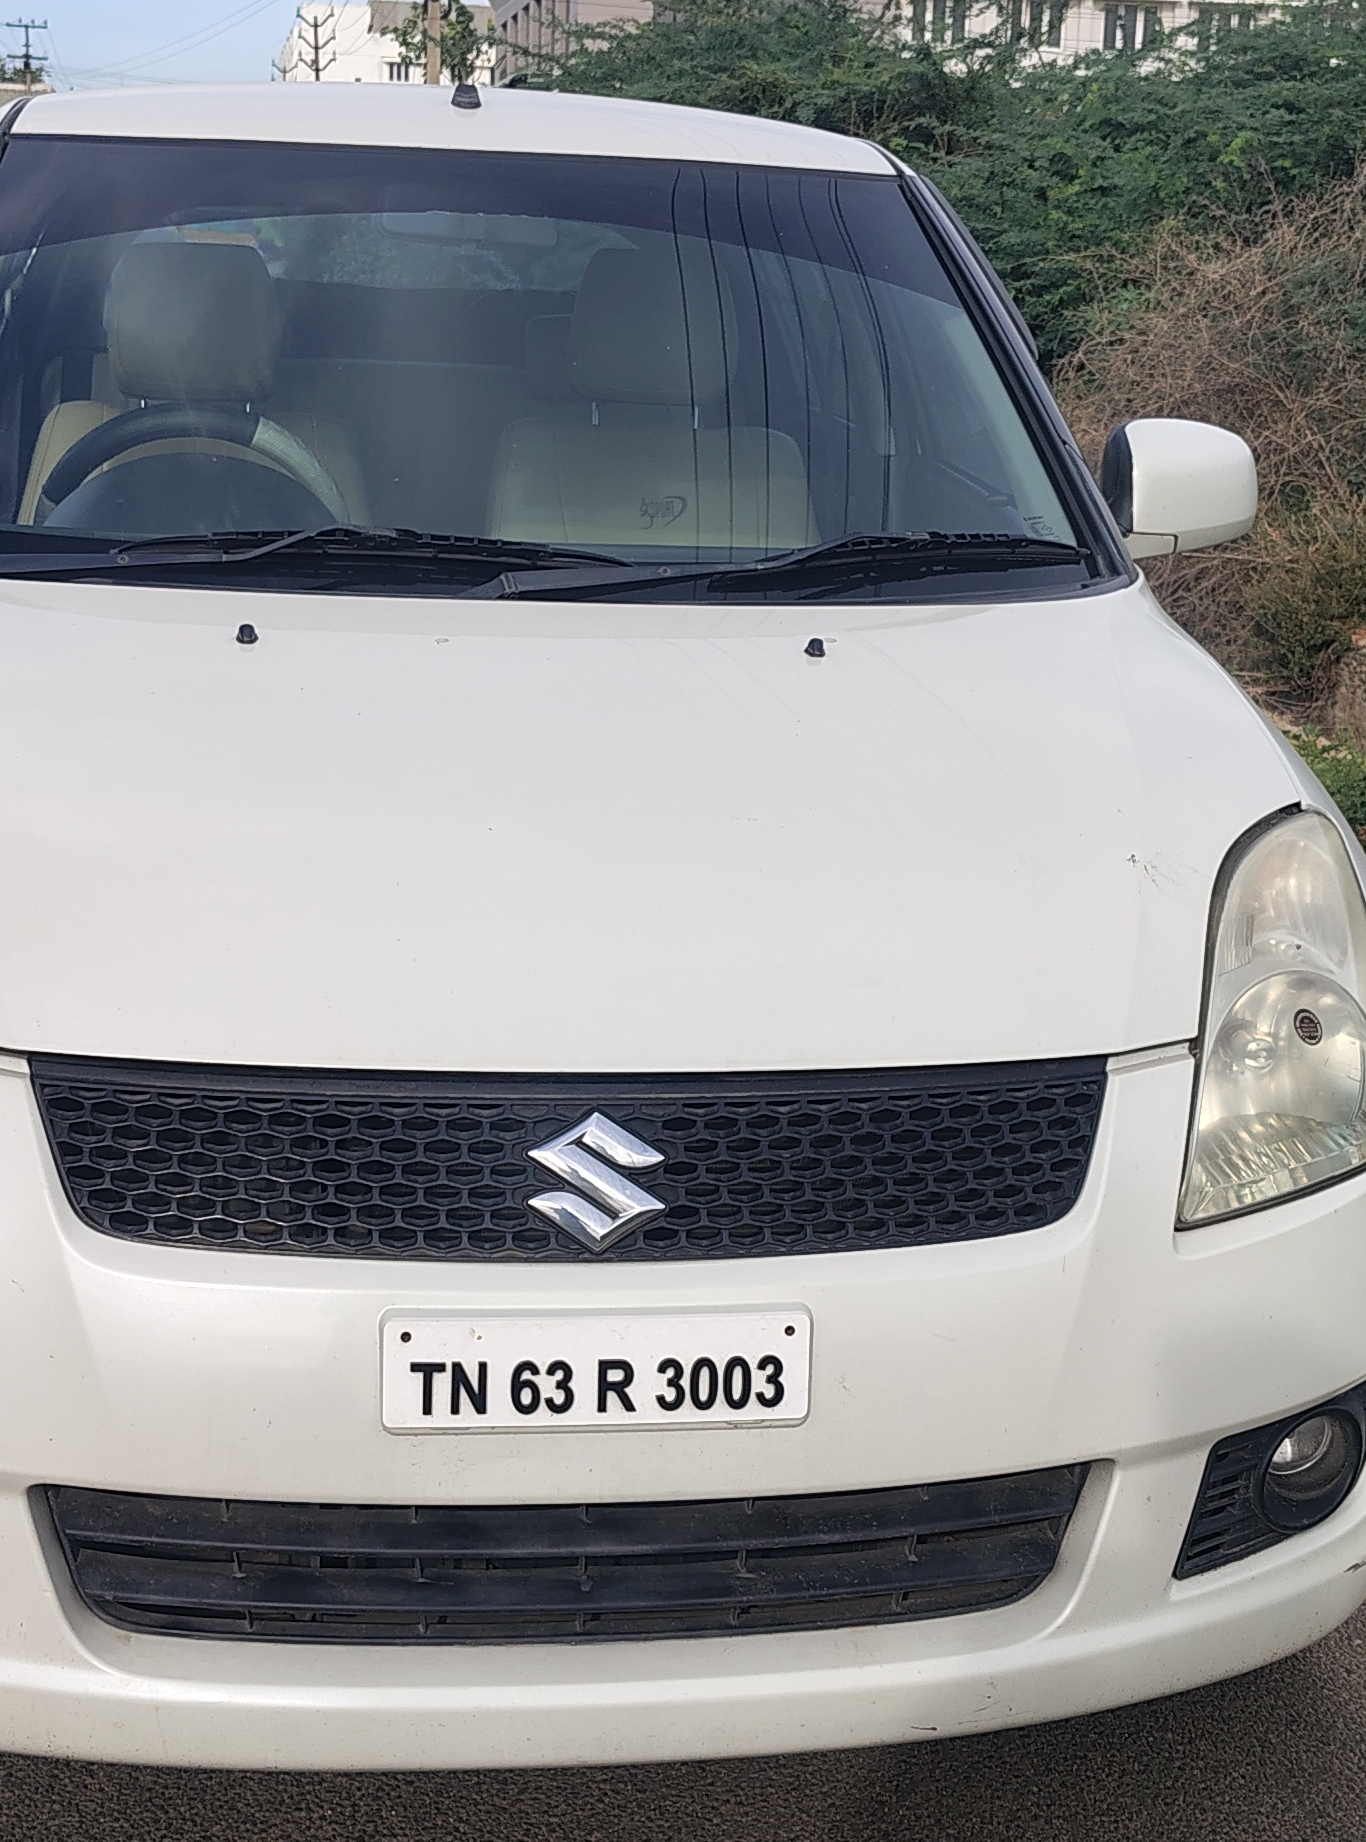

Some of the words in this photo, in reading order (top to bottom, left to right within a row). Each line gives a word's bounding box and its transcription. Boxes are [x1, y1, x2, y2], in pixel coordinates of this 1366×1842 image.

[410, 1361, 487, 1416] TN
[510, 1359, 575, 1415] 63
[596, 1358, 636, 1413] R
[655, 1354, 785, 1411] 3003
